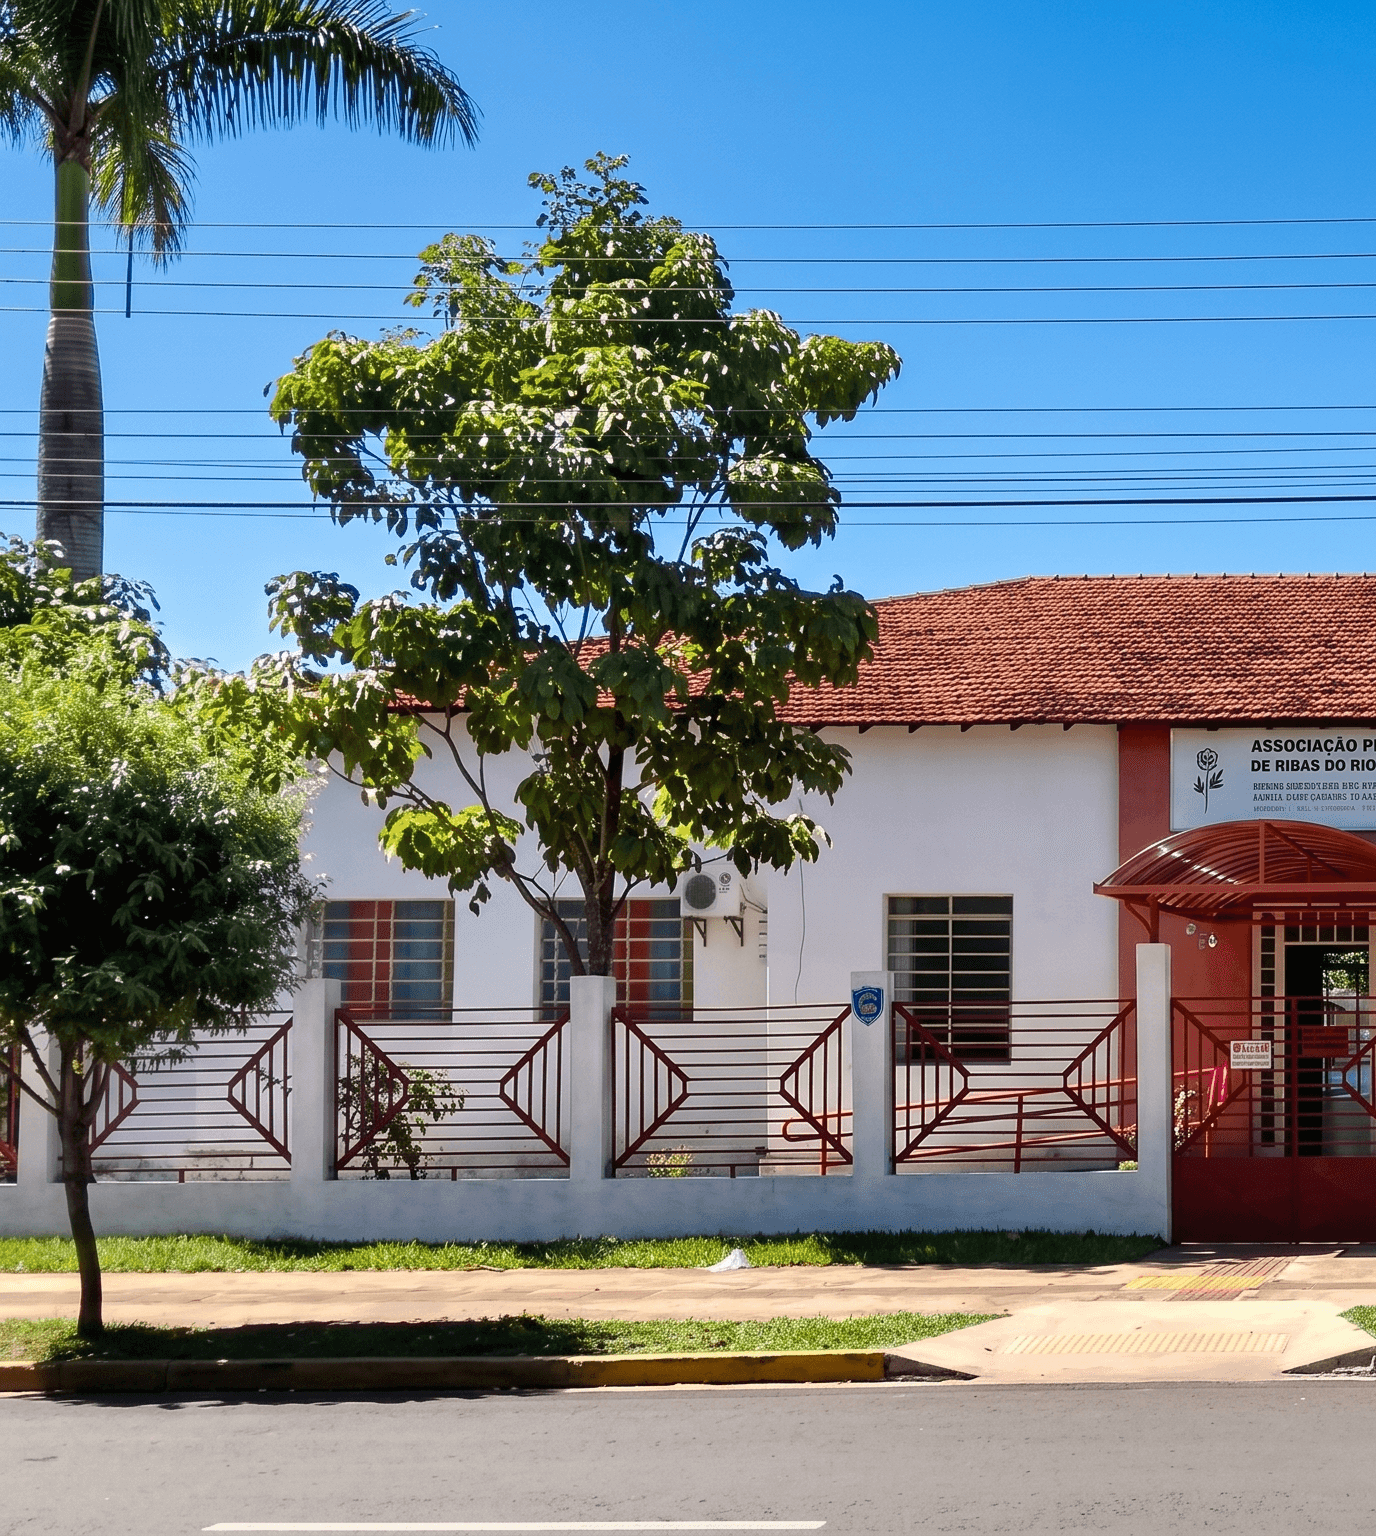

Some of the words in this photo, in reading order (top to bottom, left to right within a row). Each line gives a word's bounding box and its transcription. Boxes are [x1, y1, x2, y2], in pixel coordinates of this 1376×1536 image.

[1251, 737, 1358, 756] ASSOCIAÇÃO
[1251, 759, 1271, 772] DE
[1275, 759, 1321, 772] RIBAS
[1324, 759, 1346, 772] DO
[1350, 758, 1376, 772] RIO
